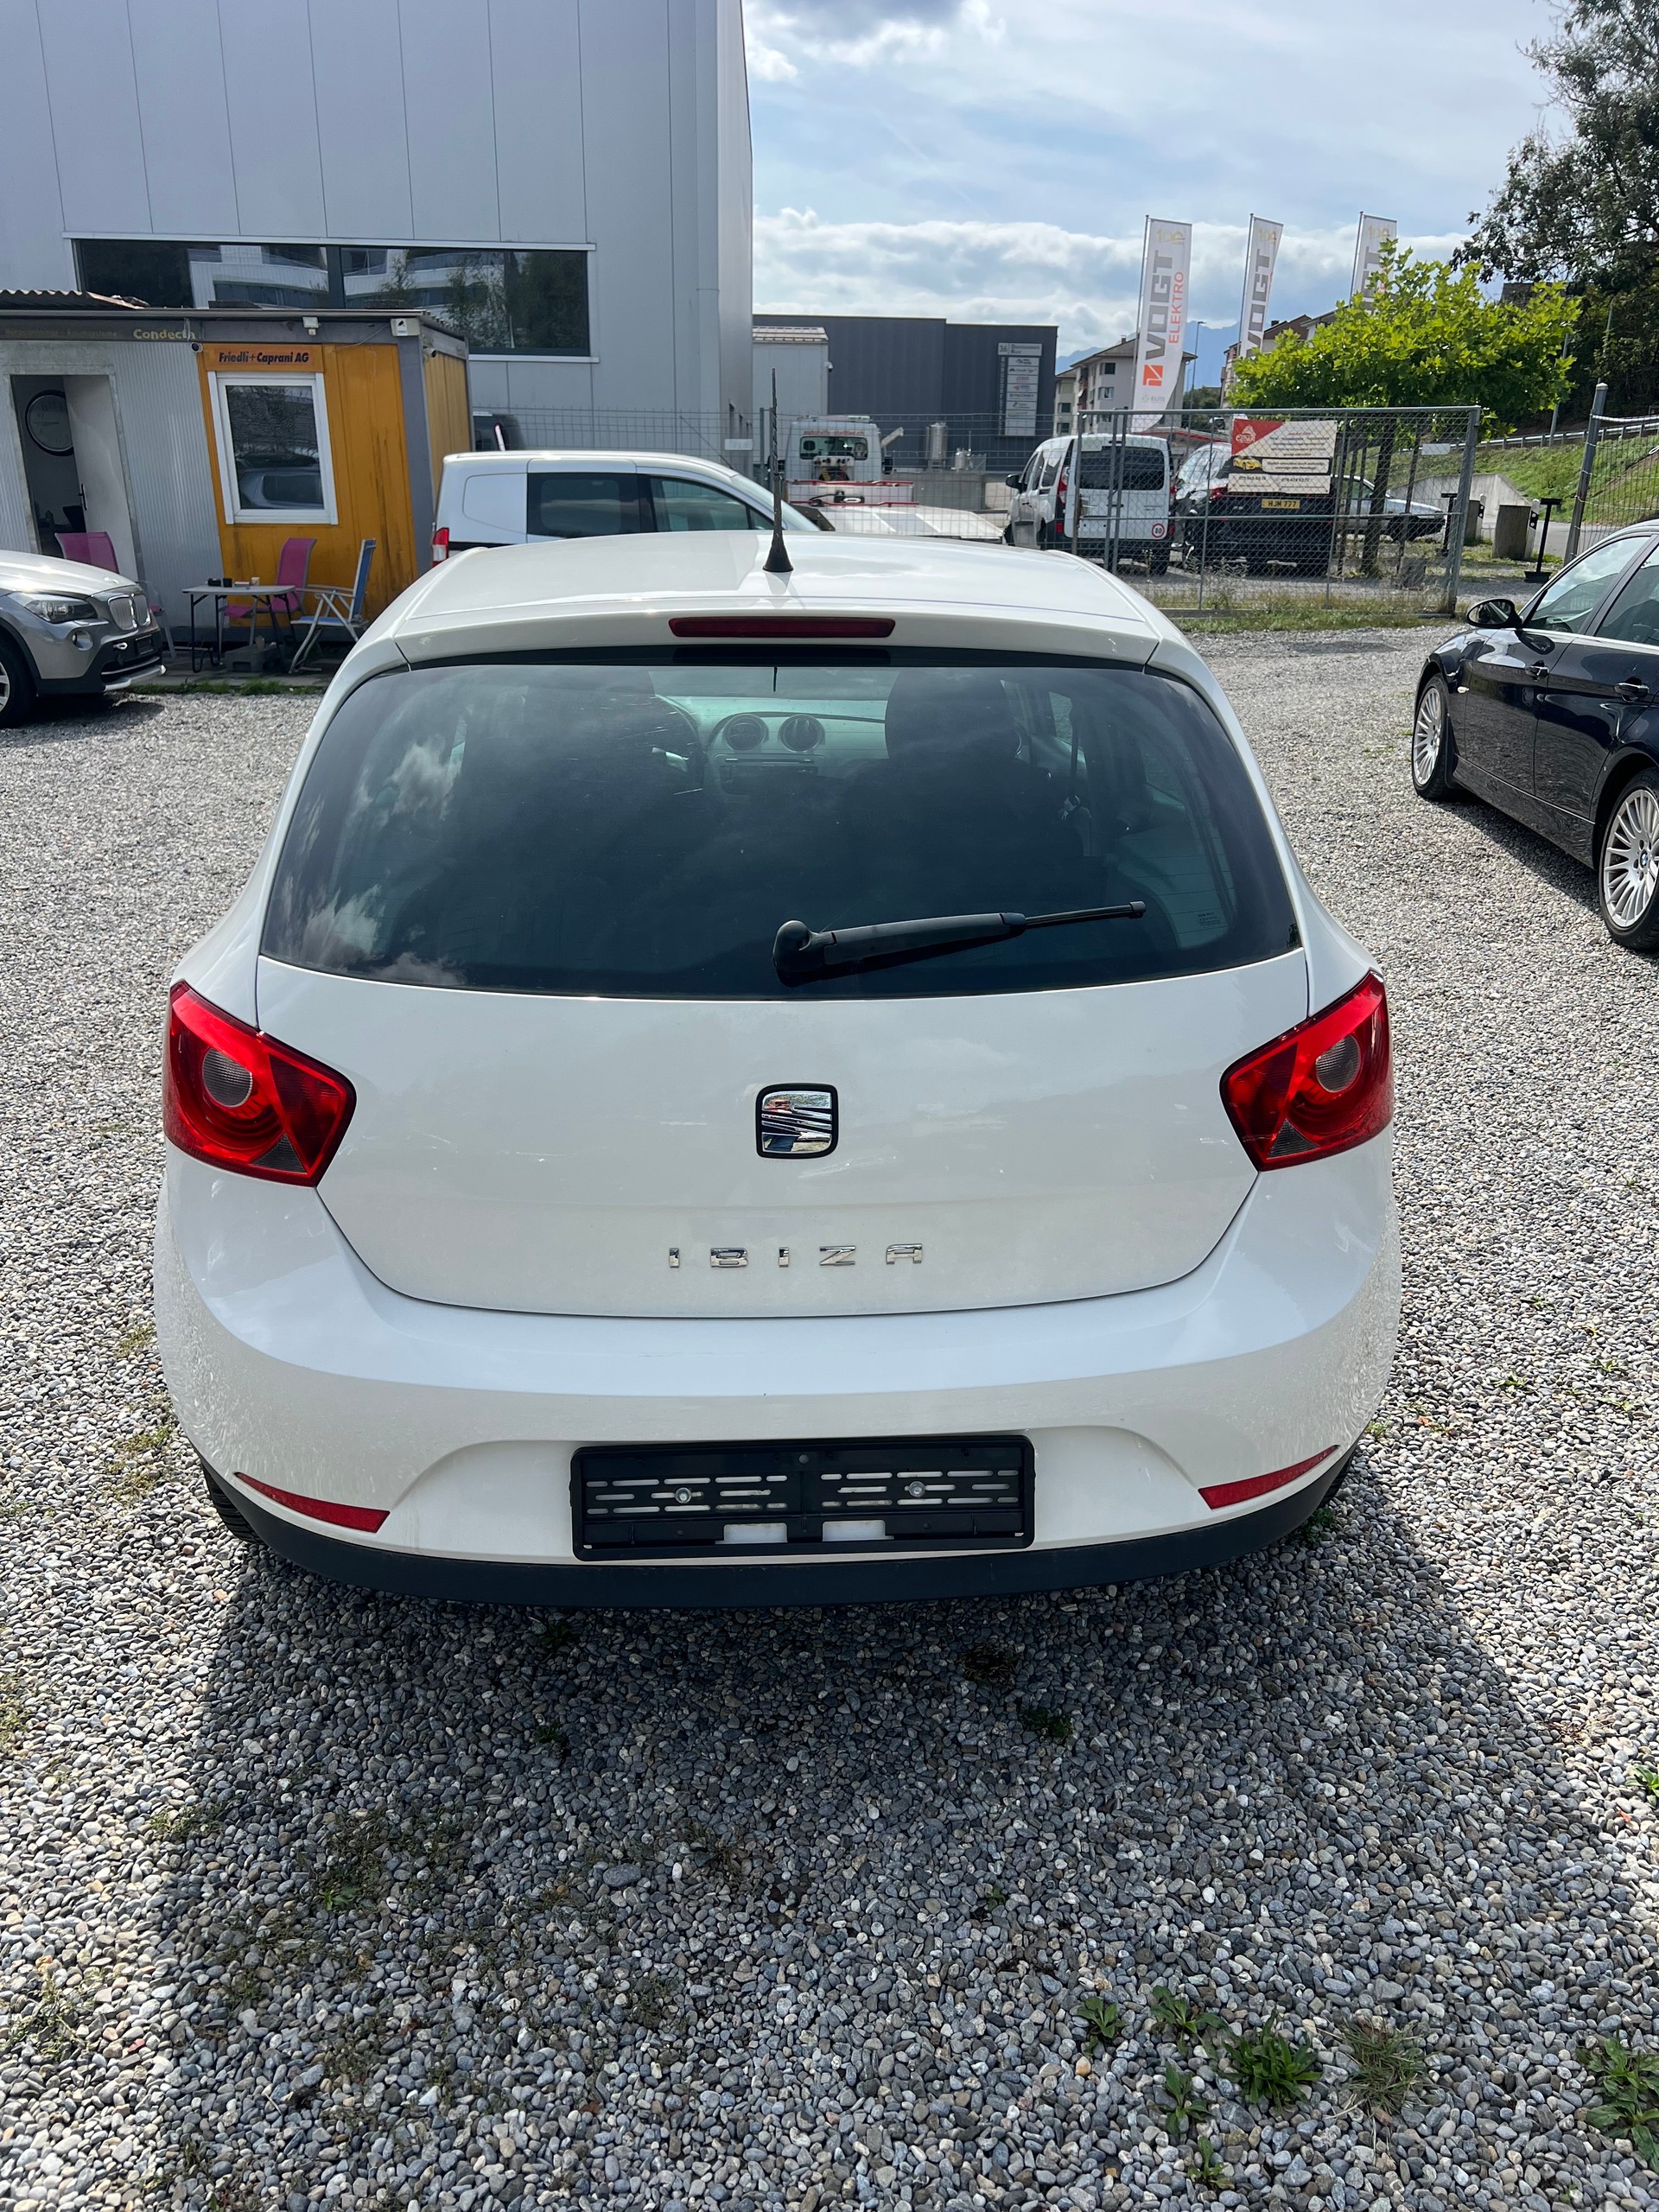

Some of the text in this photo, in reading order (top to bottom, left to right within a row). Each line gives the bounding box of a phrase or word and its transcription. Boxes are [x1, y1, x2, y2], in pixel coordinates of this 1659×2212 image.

[1145, 250, 1173, 360] VOGT
[1168, 270, 1185, 345] ELEKTRO
[295, 352, 309, 363] AG
[669, 1243, 924, 1268] IBIZA
